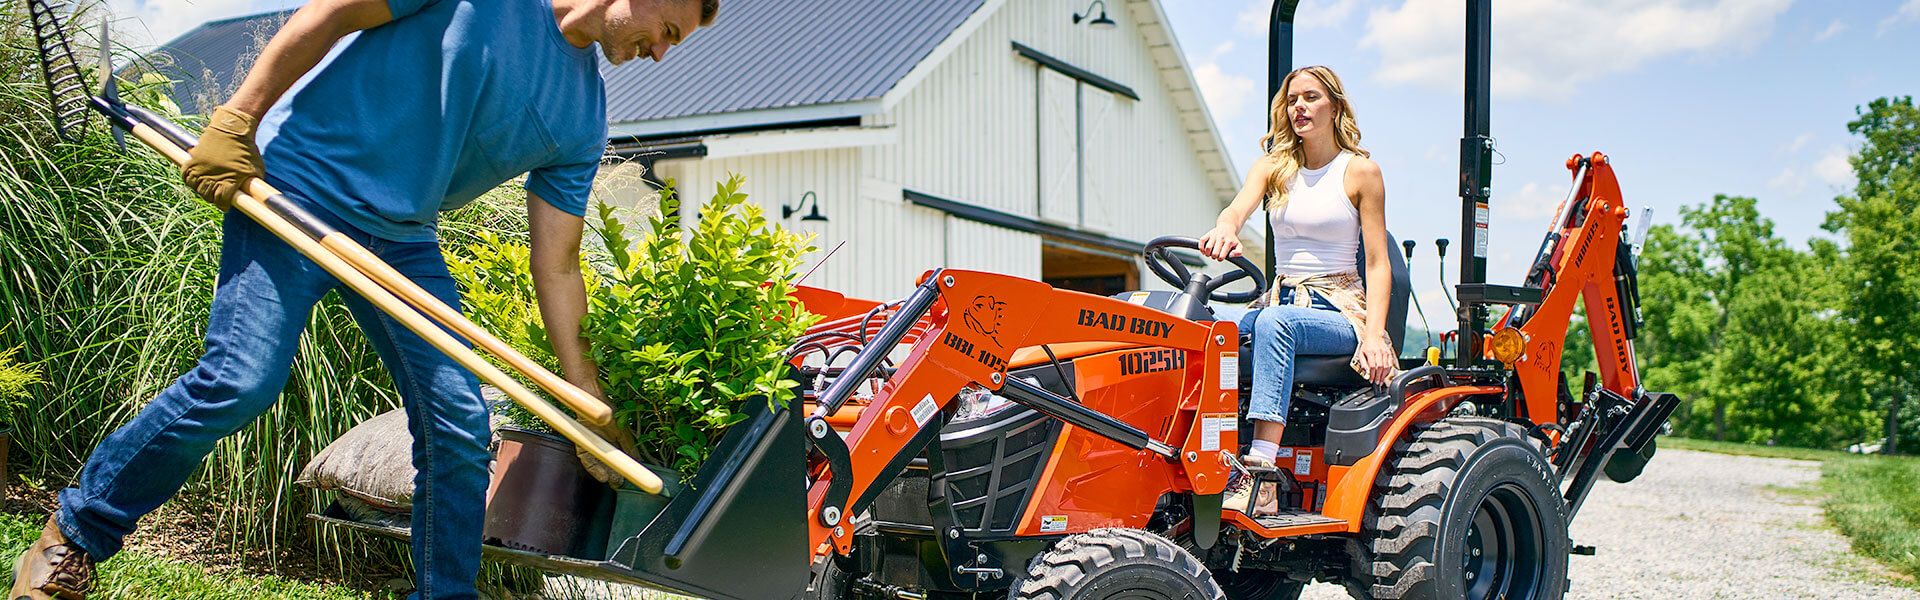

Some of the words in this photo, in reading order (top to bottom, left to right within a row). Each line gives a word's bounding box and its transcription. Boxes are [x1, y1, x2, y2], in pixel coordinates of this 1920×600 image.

[1077, 308, 1126, 331] BAD
[1129, 317, 1175, 339] BOY
[1606, 297, 1620, 335] BAD
[1615, 339, 1630, 374] BOY
[943, 331, 975, 360] BBL
[977, 349, 1008, 374] 105
[1118, 348, 1185, 376] 1025H
